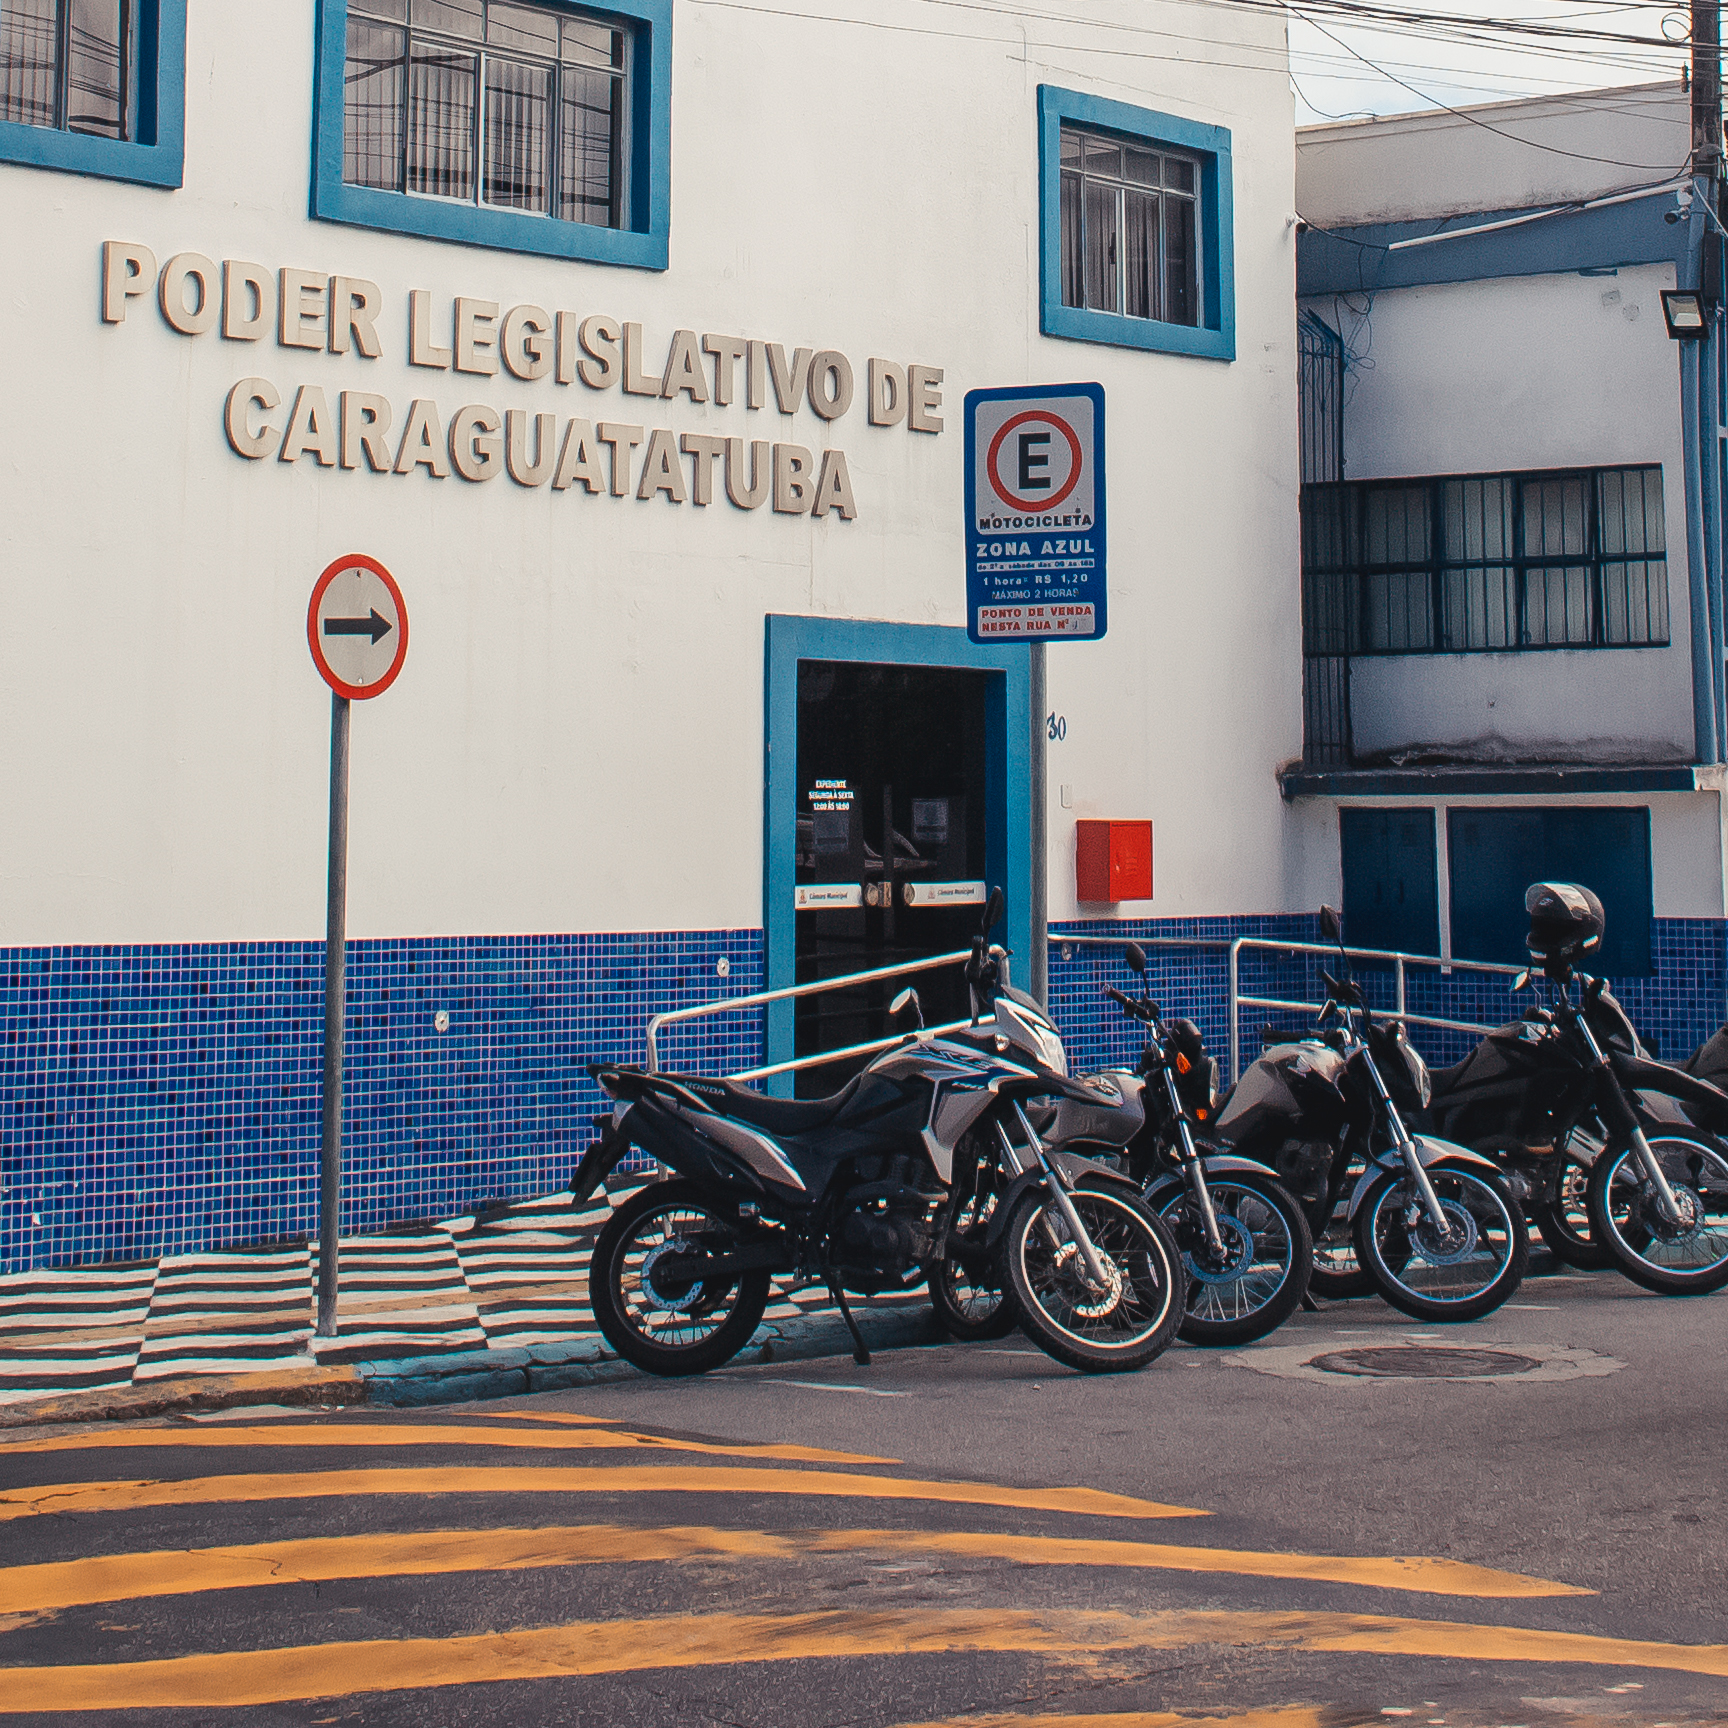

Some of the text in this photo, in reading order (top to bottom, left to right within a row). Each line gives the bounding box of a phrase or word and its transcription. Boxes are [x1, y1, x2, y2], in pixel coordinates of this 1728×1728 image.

[102, 240, 944, 434] PODER LEGISLATIVO DE
[224, 377, 857, 520] CARAGUATATUBA
[1018, 432, 1051, 490] E
[979, 514, 1092, 530] MOTOCICLETA
[977, 539, 1095, 557] ZONA AZUL
[983, 577, 988, 585] 1
[1035, 574, 1052, 584] R$
[1060, 574, 1088, 584] 1,20
[1034, 589, 1041, 598] 2
[1044, 588, 1079, 598] HORAS
[981, 606, 1092, 618] PONTO DE VENDA
[981, 621, 1021, 631] NESTA
[1026, 620, 1051, 630] RUA
[1046, 710, 1067, 742] 30
[684, 1081, 726, 1096] HONDA
